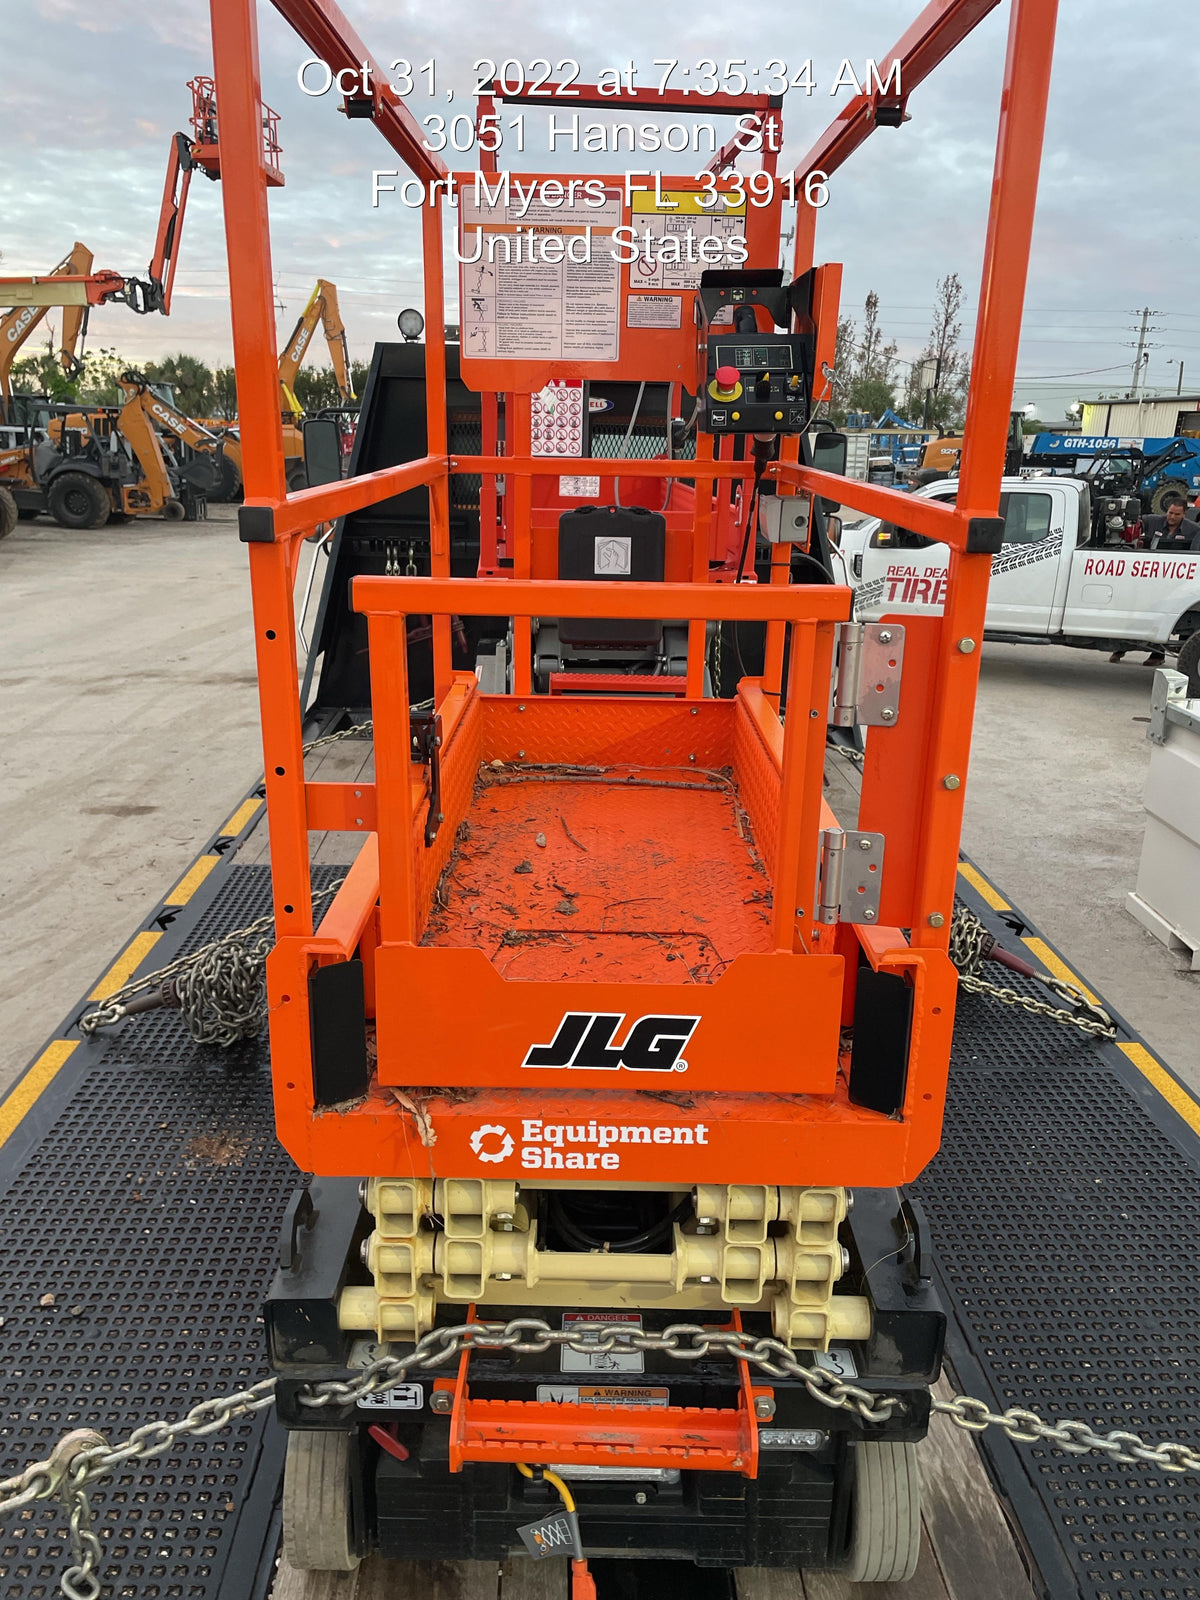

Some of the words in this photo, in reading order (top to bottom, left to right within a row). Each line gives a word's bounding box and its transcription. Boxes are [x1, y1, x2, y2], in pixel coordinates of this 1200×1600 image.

[7, 306, 39, 342] CASE
[291, 327, 310, 363] CASE
[151, 403, 187, 435] CASE
[1063, 438, 1117, 449] GTH-1056
[886, 565, 920, 577] REAL
[1084, 558, 1126, 577] ROAD
[1131, 560, 1198, 580] SERVICE
[520, 1011, 702, 1072] JLG
[520, 1119, 709, 1148] Equipment
[520, 1147, 620, 1171] Share
[604, 1389, 652, 1397] WARNING
